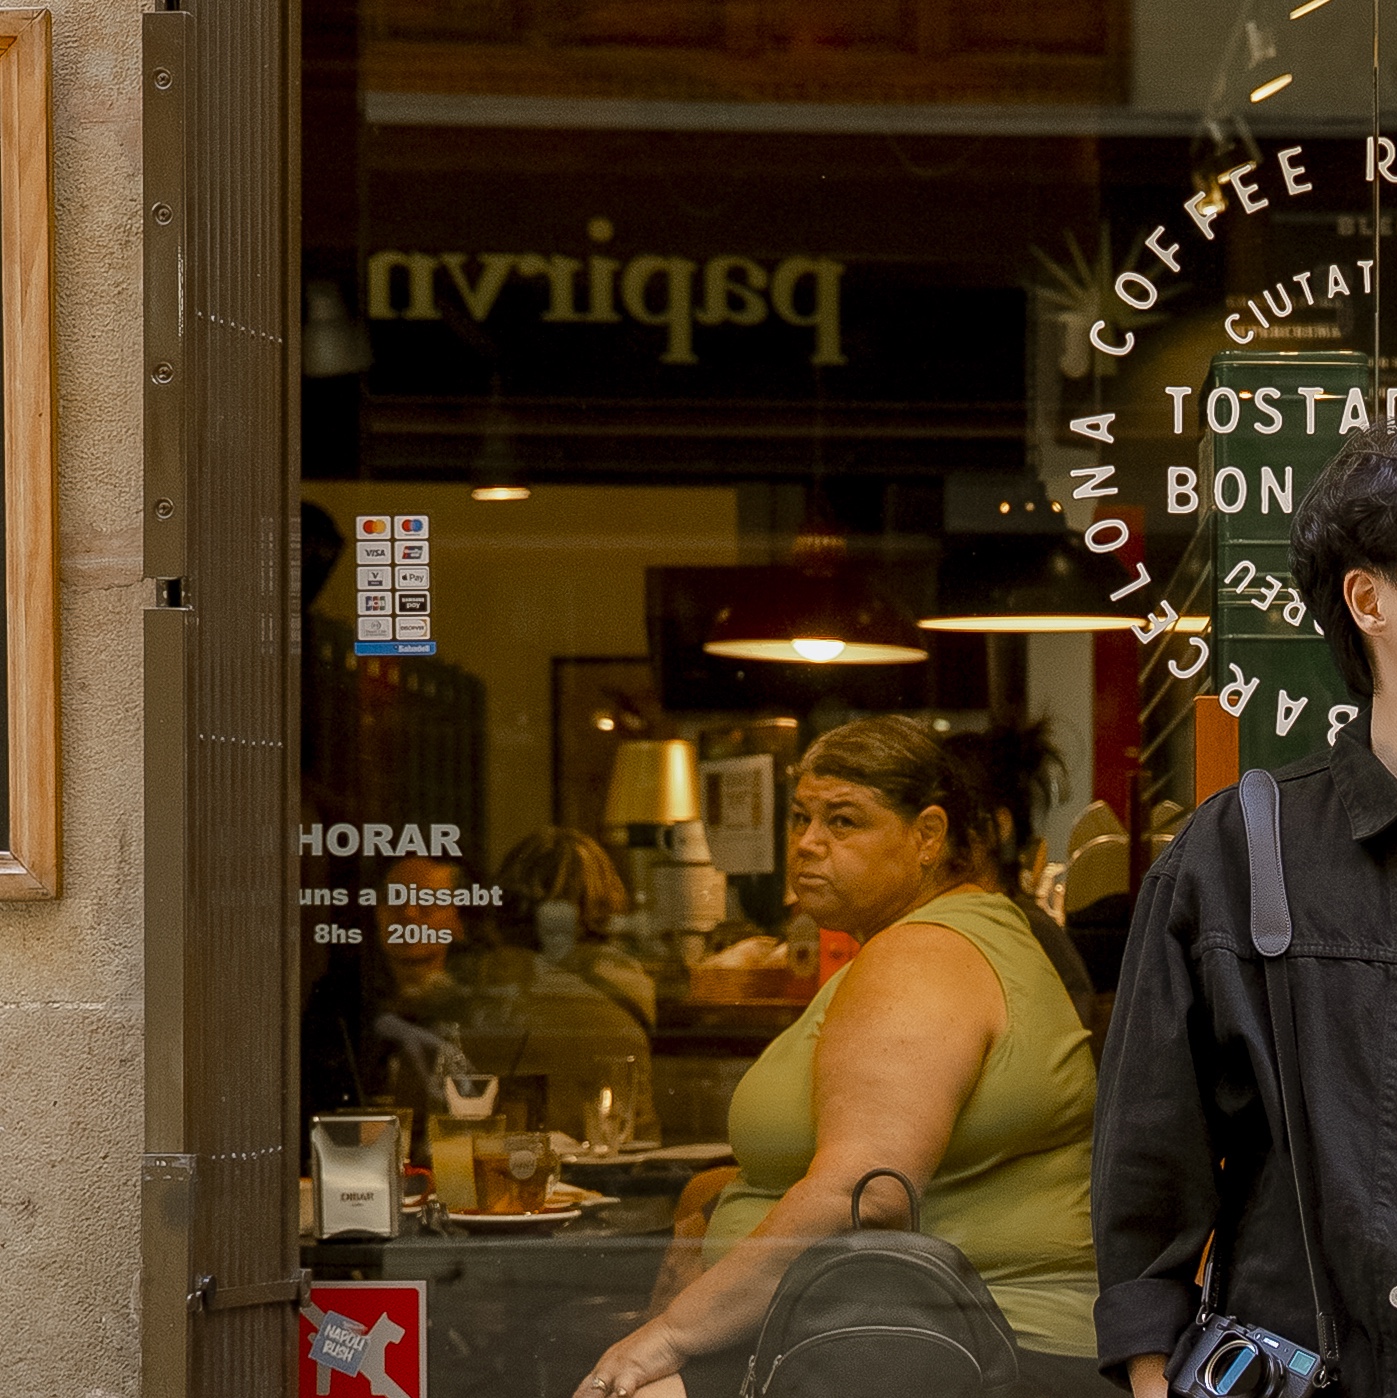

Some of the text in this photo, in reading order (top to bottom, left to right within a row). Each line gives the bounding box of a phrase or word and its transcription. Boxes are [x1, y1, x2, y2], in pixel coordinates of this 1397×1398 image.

[1089, 146, 1313, 356] COFFEE
[1224, 260, 1374, 345] CIUTAT
[1166, 465, 1294, 515] BON
[364, 549, 386, 557] VISA
[409, 573, 425, 583] Pay
[299, 823, 463, 857] HORAR
[358, 888, 377, 906] a
[387, 883, 503, 906] Dissabt
[313, 923, 454, 944] 8hs 20hs
[324, 1323, 367, 1351] NAPOLI
